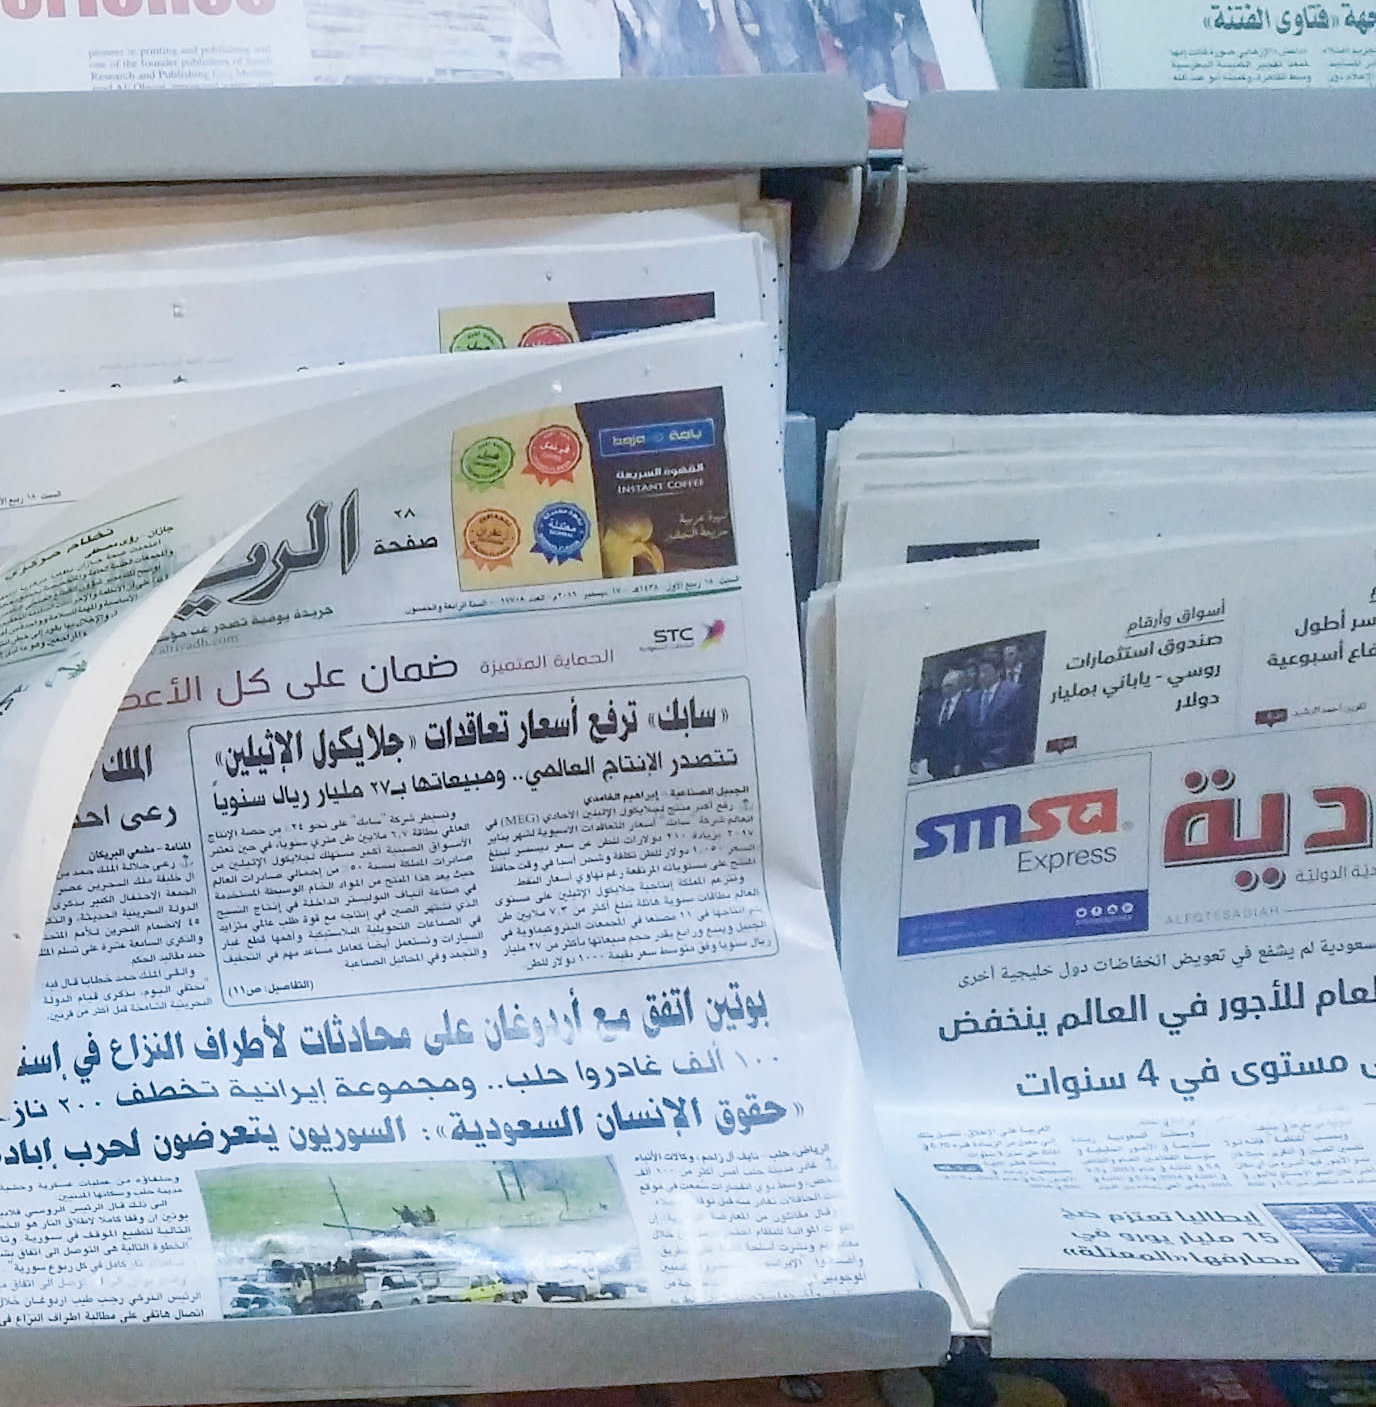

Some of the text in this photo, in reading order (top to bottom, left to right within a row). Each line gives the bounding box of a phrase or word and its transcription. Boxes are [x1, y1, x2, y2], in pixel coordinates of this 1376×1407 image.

[372, 532, 439, 556] صفحة
[653, 627, 694, 644] STC
[1126, 598, 1226, 634] أسواق وأرقام
[1065, 633, 1224, 672] صندوق استثمارات
[216, 654, 459, 708] ضمان على كل
[425, 709, 509, 751] تعاقدات
[519, 698, 578, 740] أسعار
[589, 701, 639, 744] ترفع
[913, 788, 1119, 860] smsa
[1017, 846, 1118, 875] Express
[939, 979, 1305, 1043] للأجور في العالم ينخفض
[1016, 1051, 1350, 1102] مستوى في 4 سنوات
